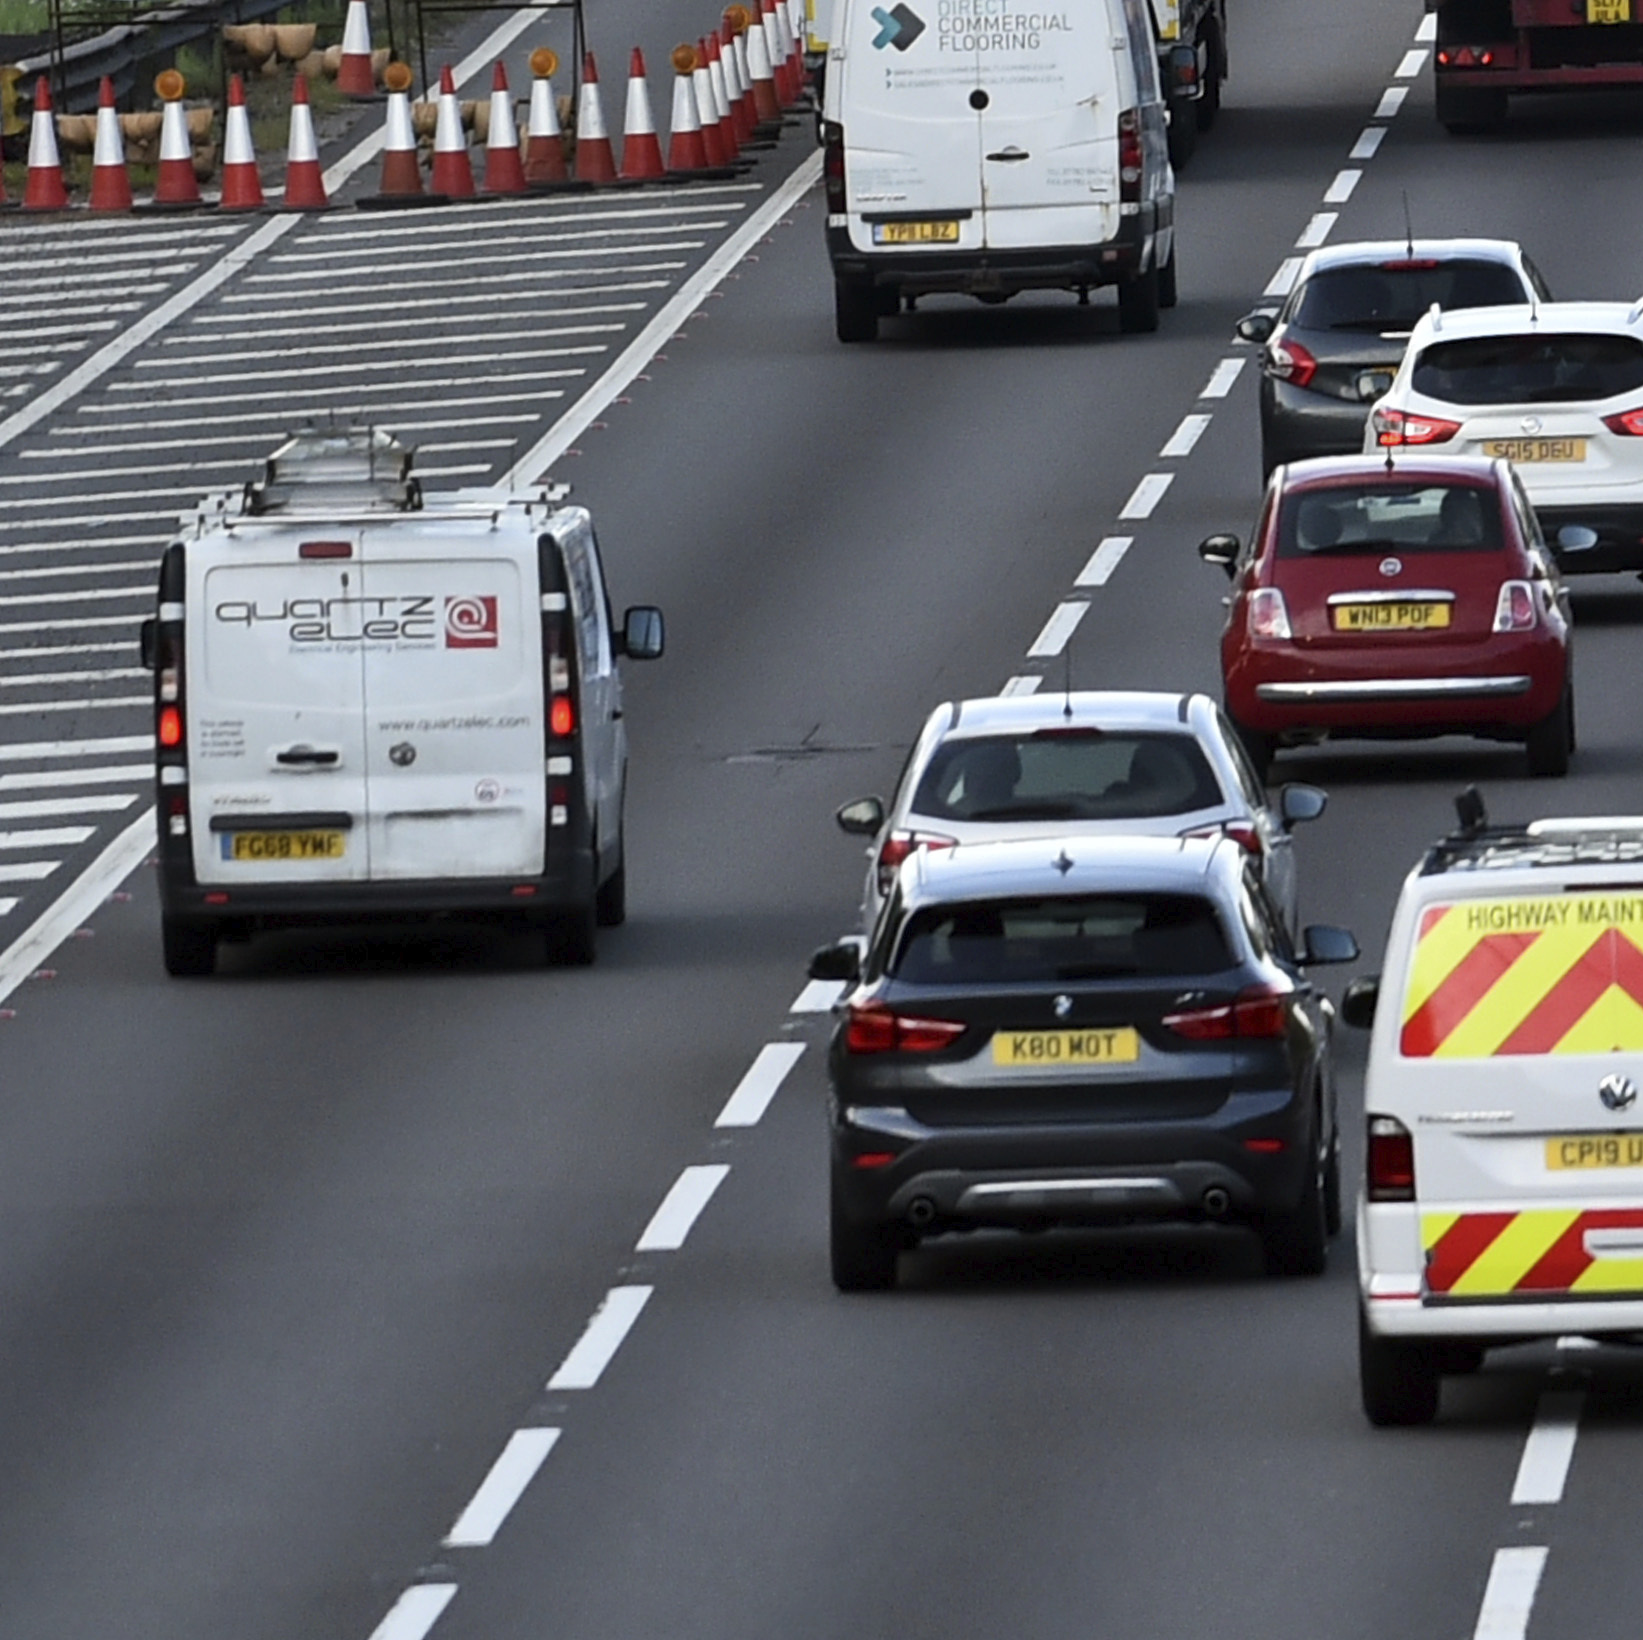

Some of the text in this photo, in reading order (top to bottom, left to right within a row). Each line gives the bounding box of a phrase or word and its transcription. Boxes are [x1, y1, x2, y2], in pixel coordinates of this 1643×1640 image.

[938, 13, 1073, 35] COMMERCIAL
[938, 32, 1041, 52] FLOORING
[1493, 441, 1533, 461] SG15
[1348, 606, 1392, 627] WN13
[378, 714, 531, 731] www.quartzelec.com
[1466, 901, 1571, 930] HIGHWAY
[1011, 1033, 1118, 1059] K80 MOT
[1560, 1137, 1620, 1165] CP19
